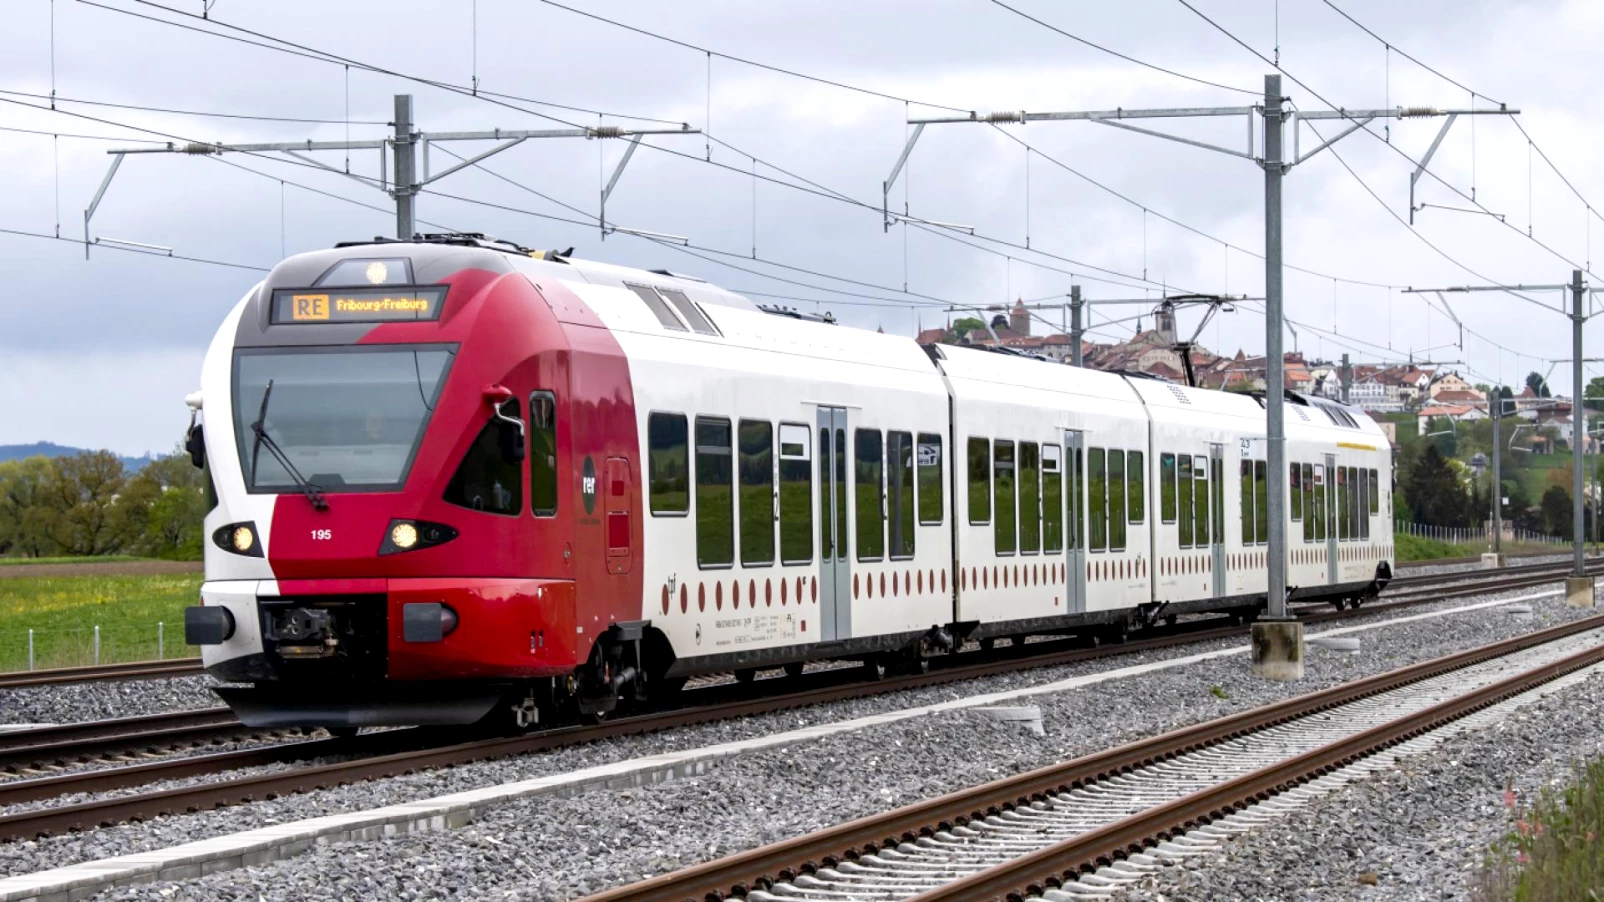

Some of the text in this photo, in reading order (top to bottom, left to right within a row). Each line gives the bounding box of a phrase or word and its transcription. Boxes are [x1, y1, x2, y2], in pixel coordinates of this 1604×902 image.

[297, 298, 323, 316] RE
[582, 476, 596, 494] rer
[310, 529, 332, 540] 195
